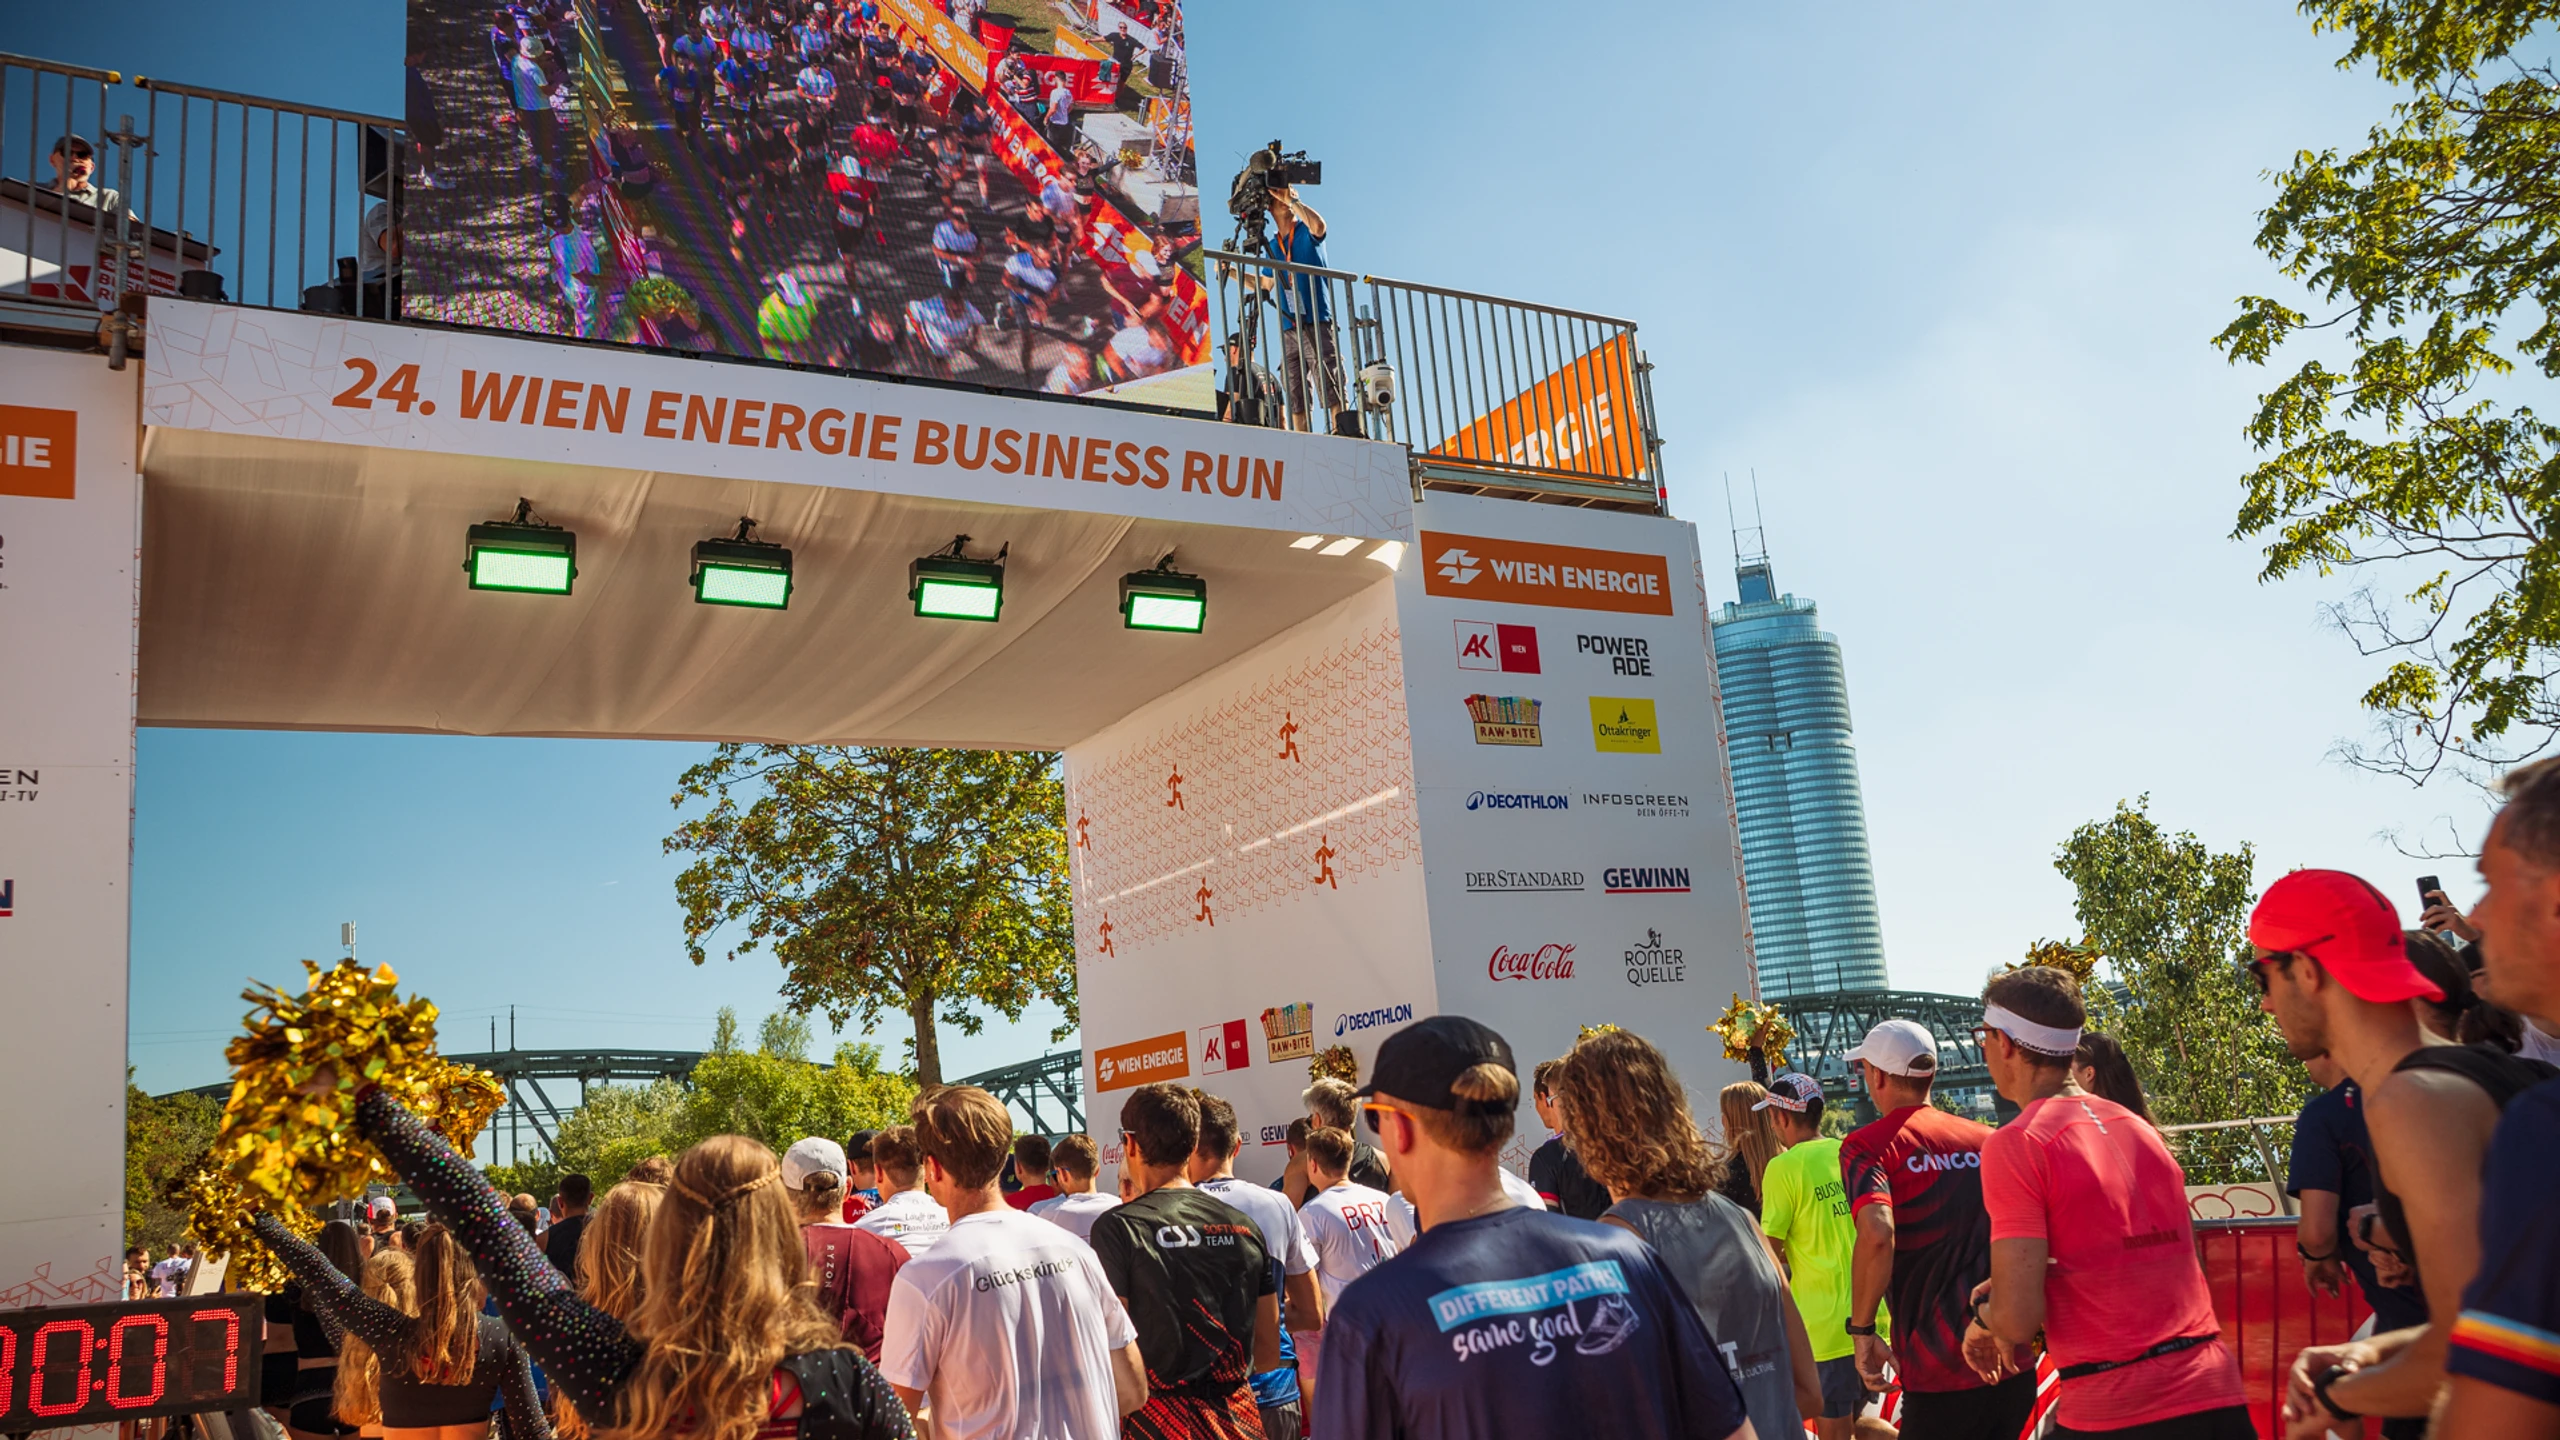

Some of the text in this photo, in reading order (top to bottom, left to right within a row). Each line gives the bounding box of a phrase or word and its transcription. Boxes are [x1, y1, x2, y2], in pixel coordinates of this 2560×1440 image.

[331, 357, 1284, 501] 24. WIEN ENERGIE BUSINESS RUN
[1490, 558, 1660, 596] WIEN ENERGIE
[1462, 633, 1493, 659] AK
[1511, 644, 1527, 654] WIEN
[1577, 634, 1649, 657] POWER
[1598, 723, 1651, 740] Ottakringer
[1486, 793, 1569, 810] DECATHLON
[1583, 793, 1689, 807] INFOSCREEN
[1637, 807, 1690, 817] DEIN ÖFFI-TV
[1603, 867, 1691, 889] GEWINN
[1488, 943, 1577, 982] Coca-Cola
[1627, 966, 1685, 987] QUELLE
[1350, 1003, 1413, 1031] DECATHLON
[1117, 1047, 1184, 1075] WIEN ENERGIE
[1204, 1037, 1221, 1063] AK
[1907, 1152, 1982, 1173] CANCO
[1814, 1180, 1846, 1202] BUSIN
[1205, 1235, 1235, 1246] TEAM
[824, 1244, 835, 1288] RYZON
[1438, 1283, 1550, 1323] DIFFERENT
[1452, 1298, 1584, 1367] same goal
